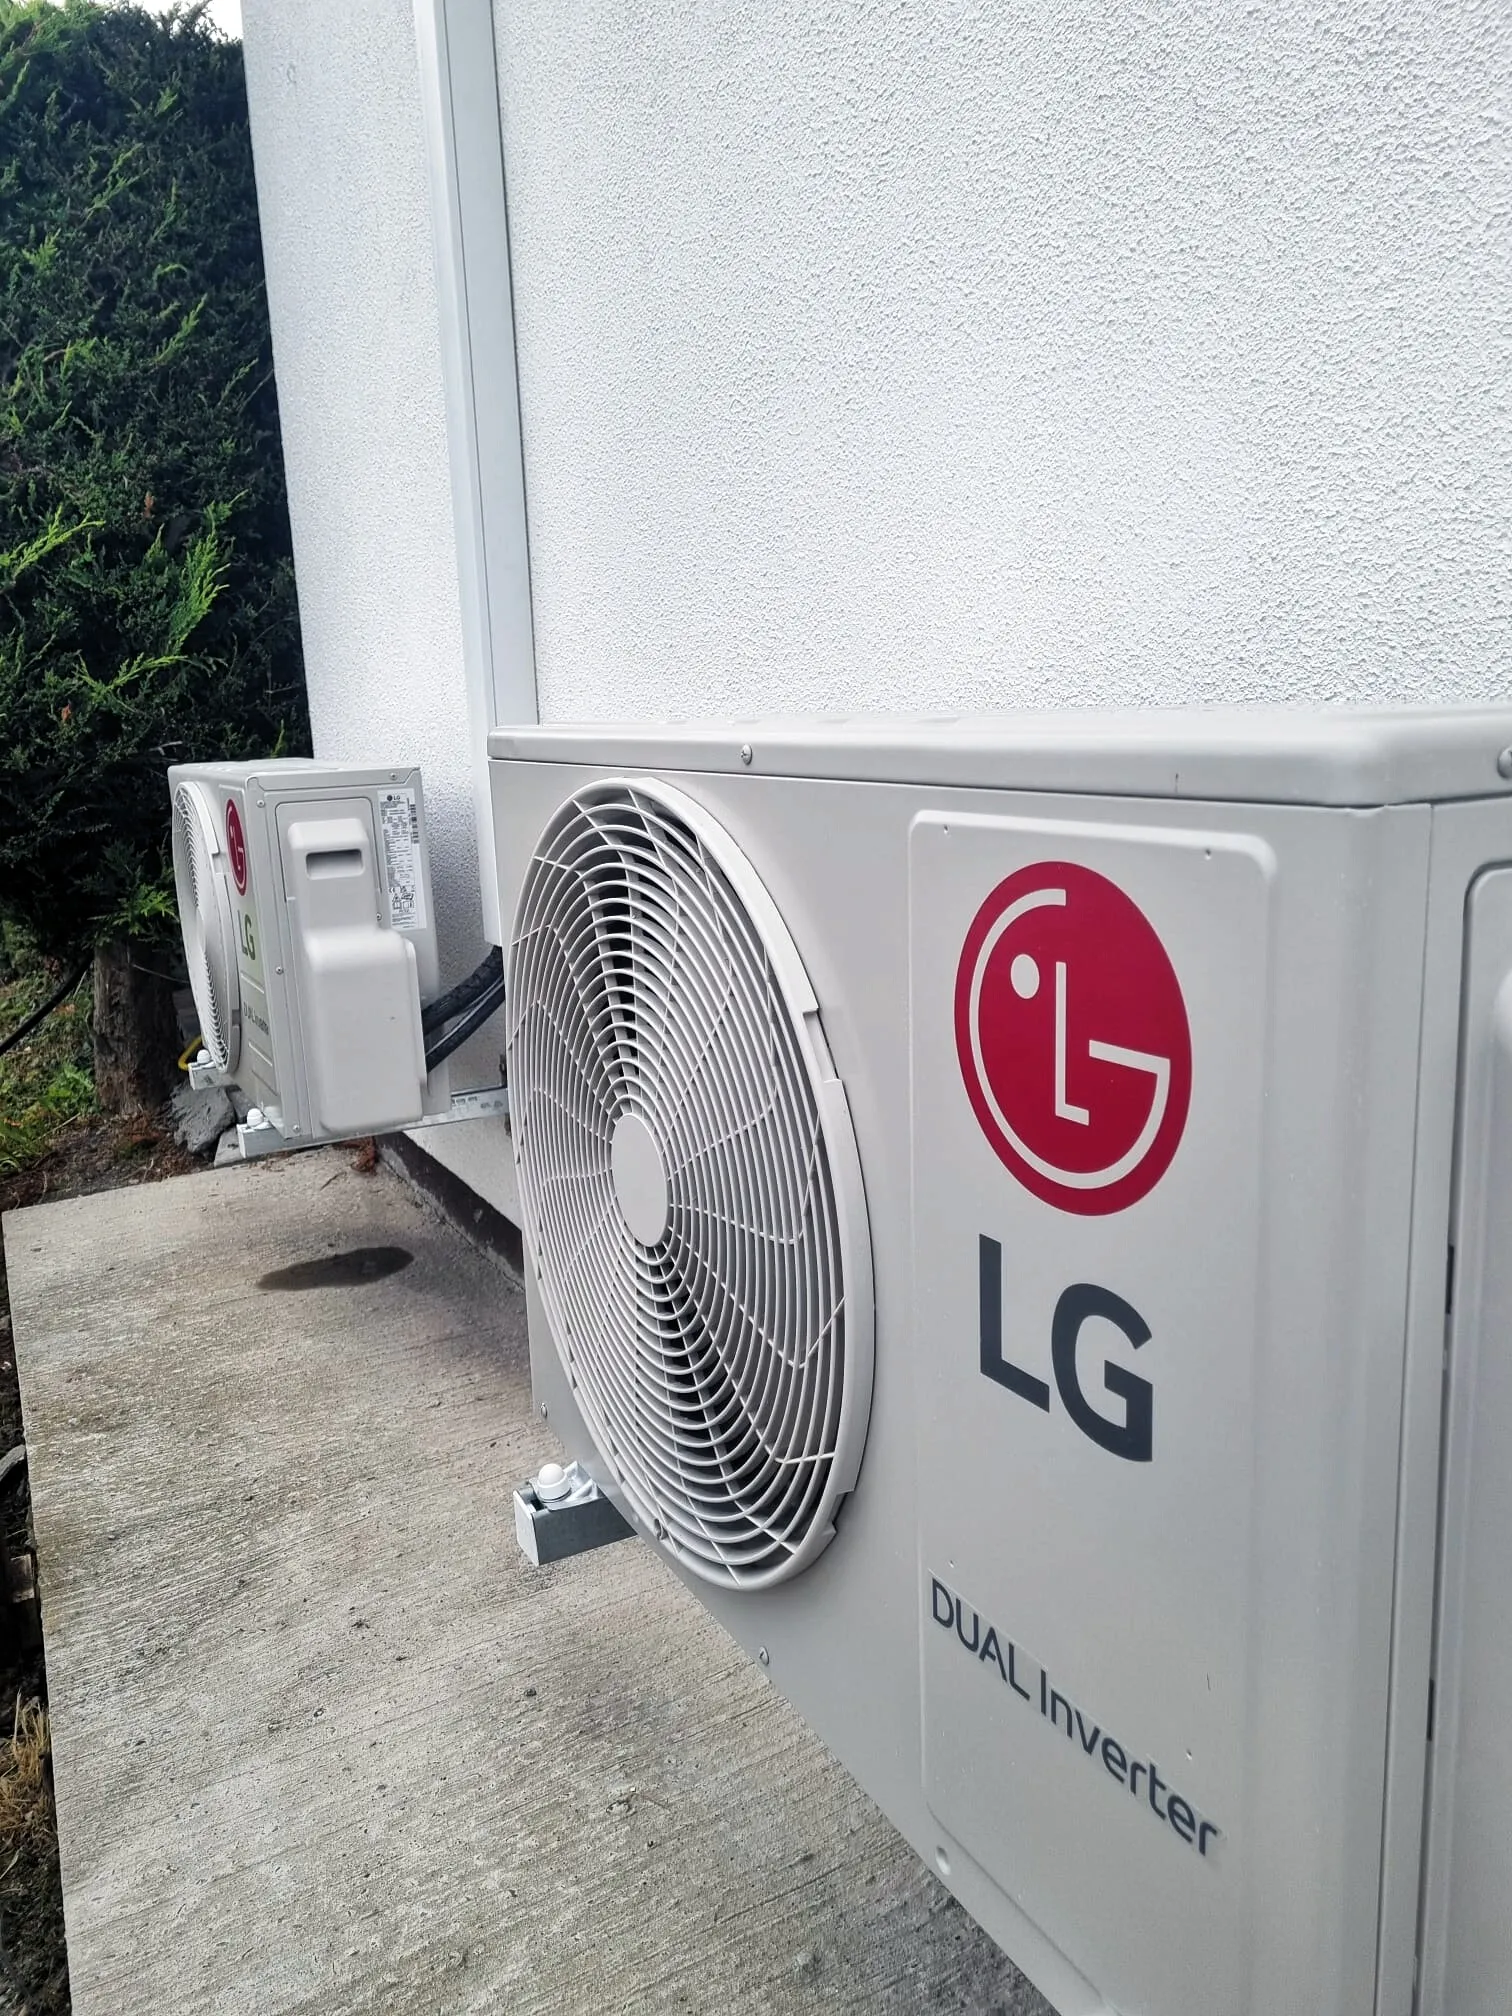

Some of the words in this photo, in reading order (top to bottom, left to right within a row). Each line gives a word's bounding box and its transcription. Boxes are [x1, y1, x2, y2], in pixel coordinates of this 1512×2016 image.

[237, 909, 256, 961] LG
[978, 1232, 1153, 1463] LG
[932, 1576, 1031, 1702] DUAL
[1040, 1667, 1218, 1857] Inverter
